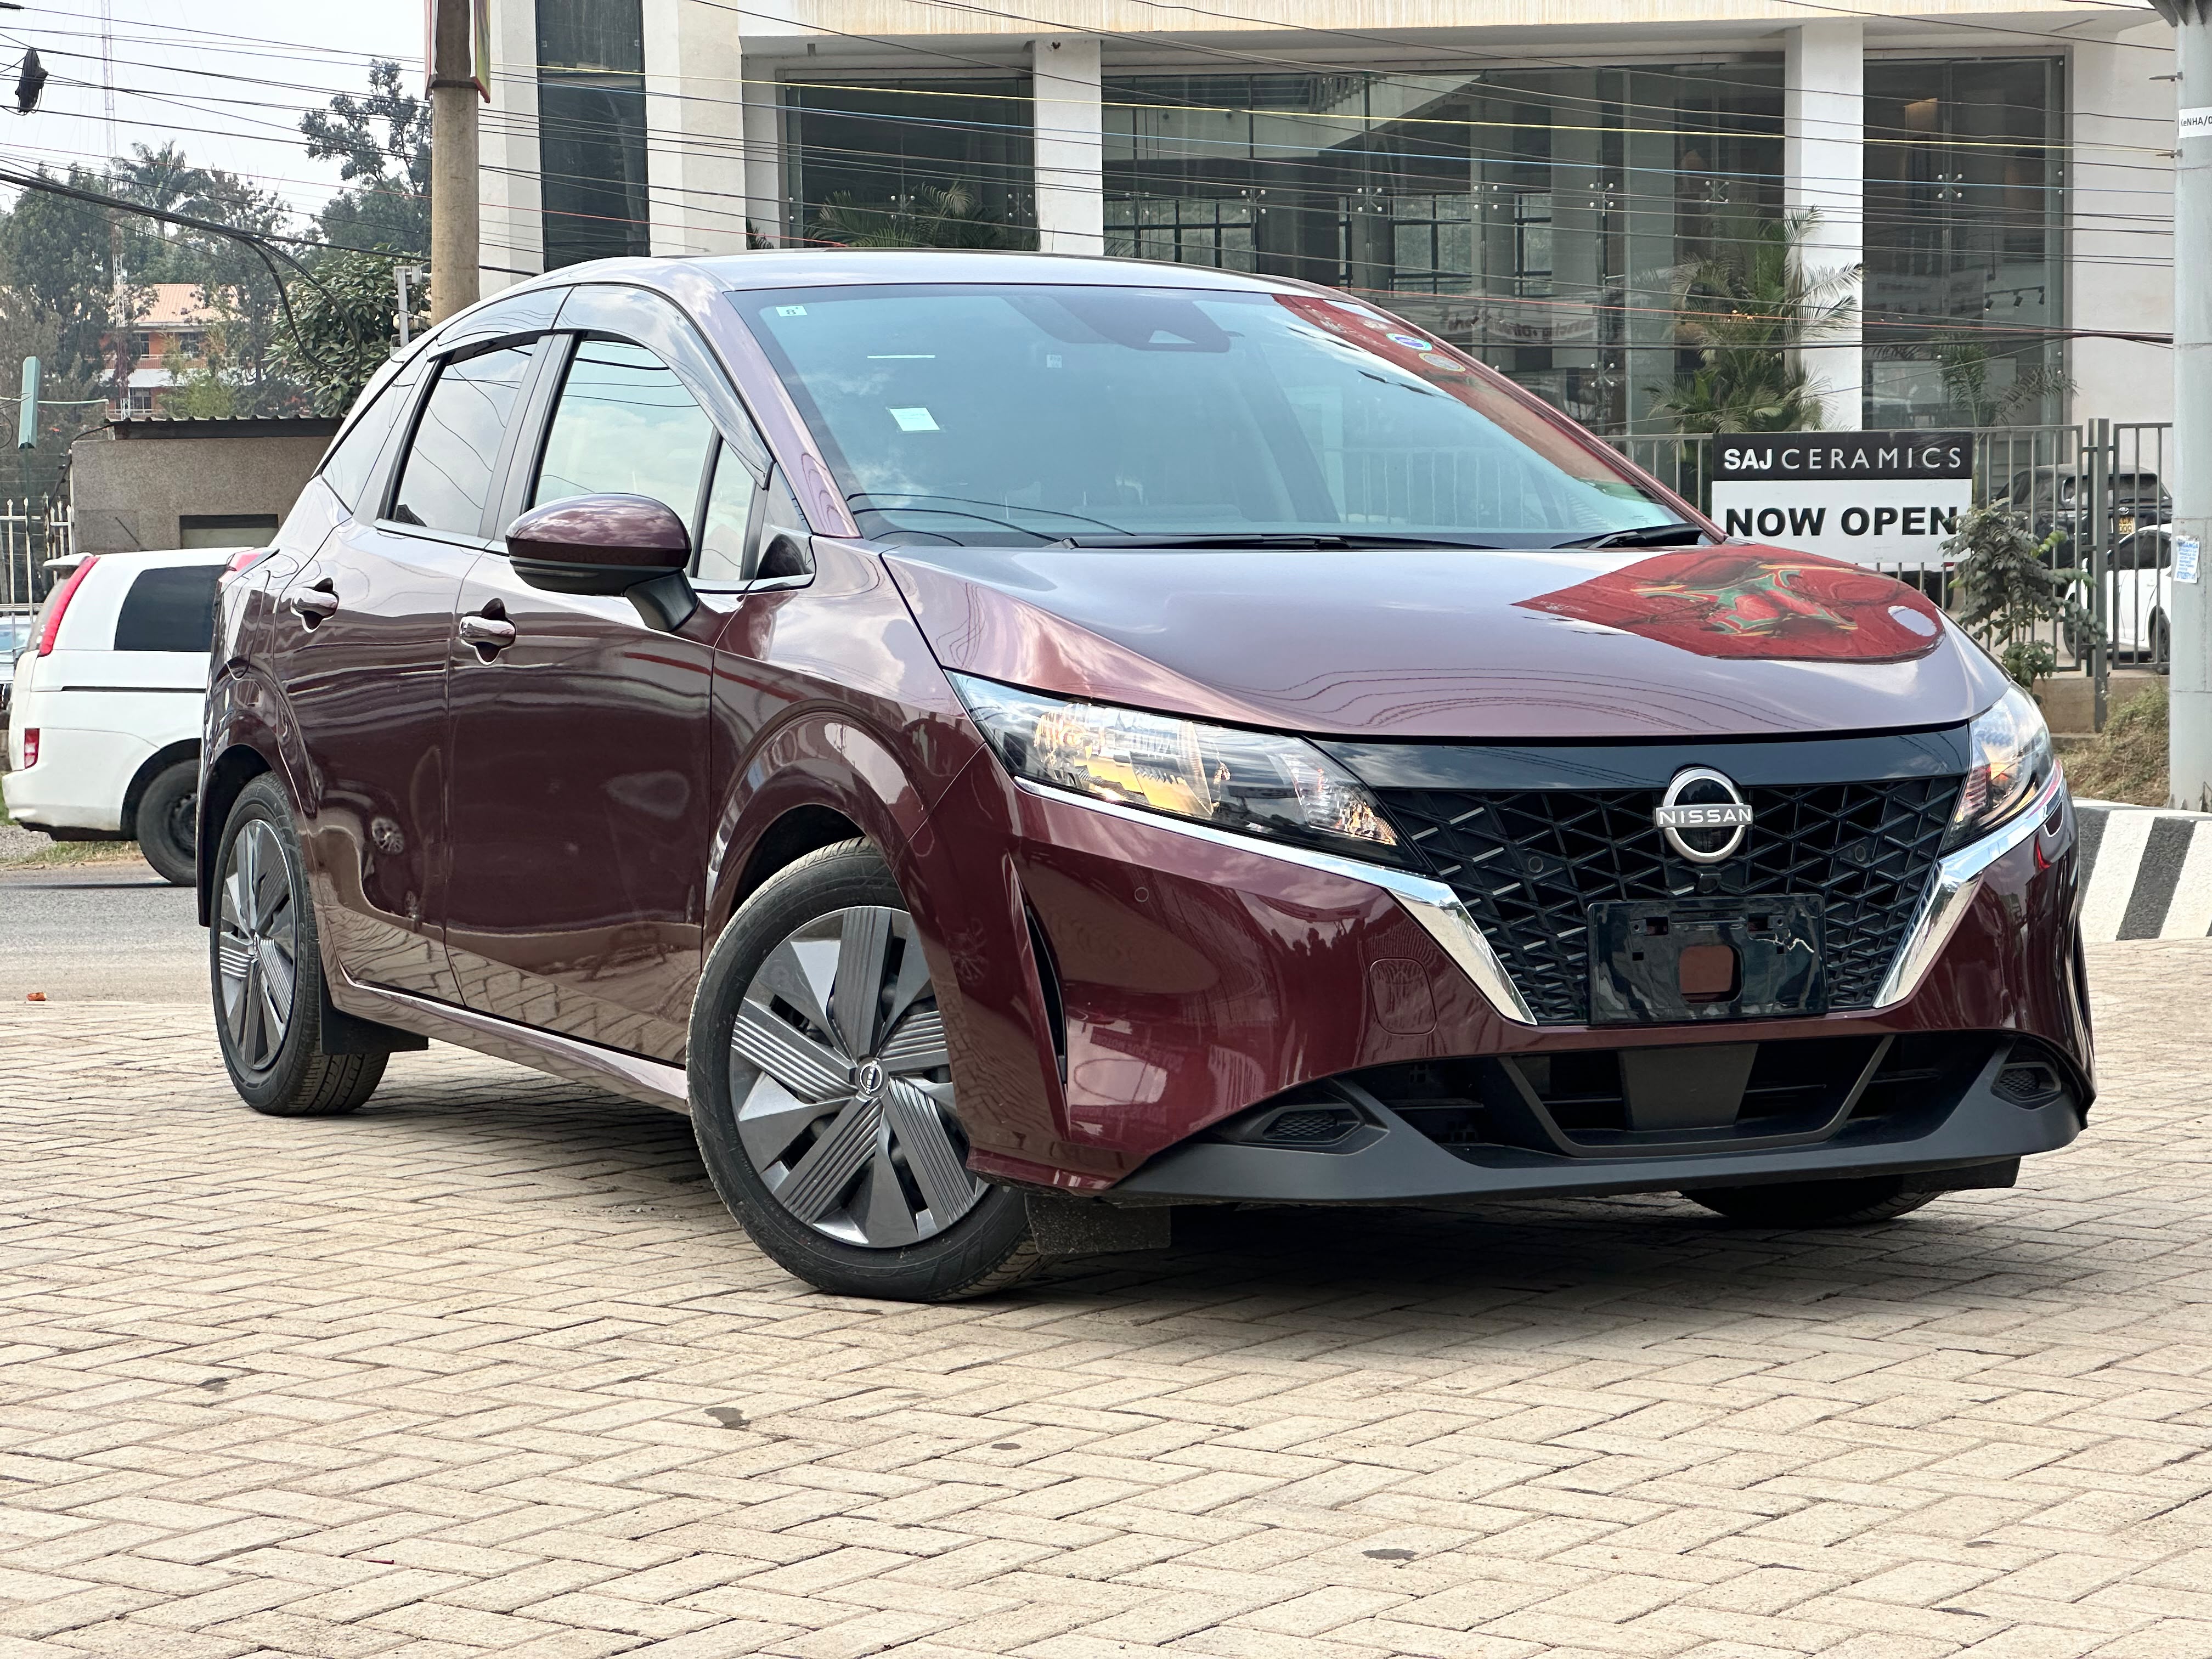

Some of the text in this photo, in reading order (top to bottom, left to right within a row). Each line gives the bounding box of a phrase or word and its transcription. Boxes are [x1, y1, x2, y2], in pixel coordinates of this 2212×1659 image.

[1724, 447, 1961, 470] SAJ CERAMICS
[1726, 506, 1957, 537] NOW OPEN
[1659, 808, 1752, 825] NISSAN
[865, 1060, 878, 1094] NISSAN
